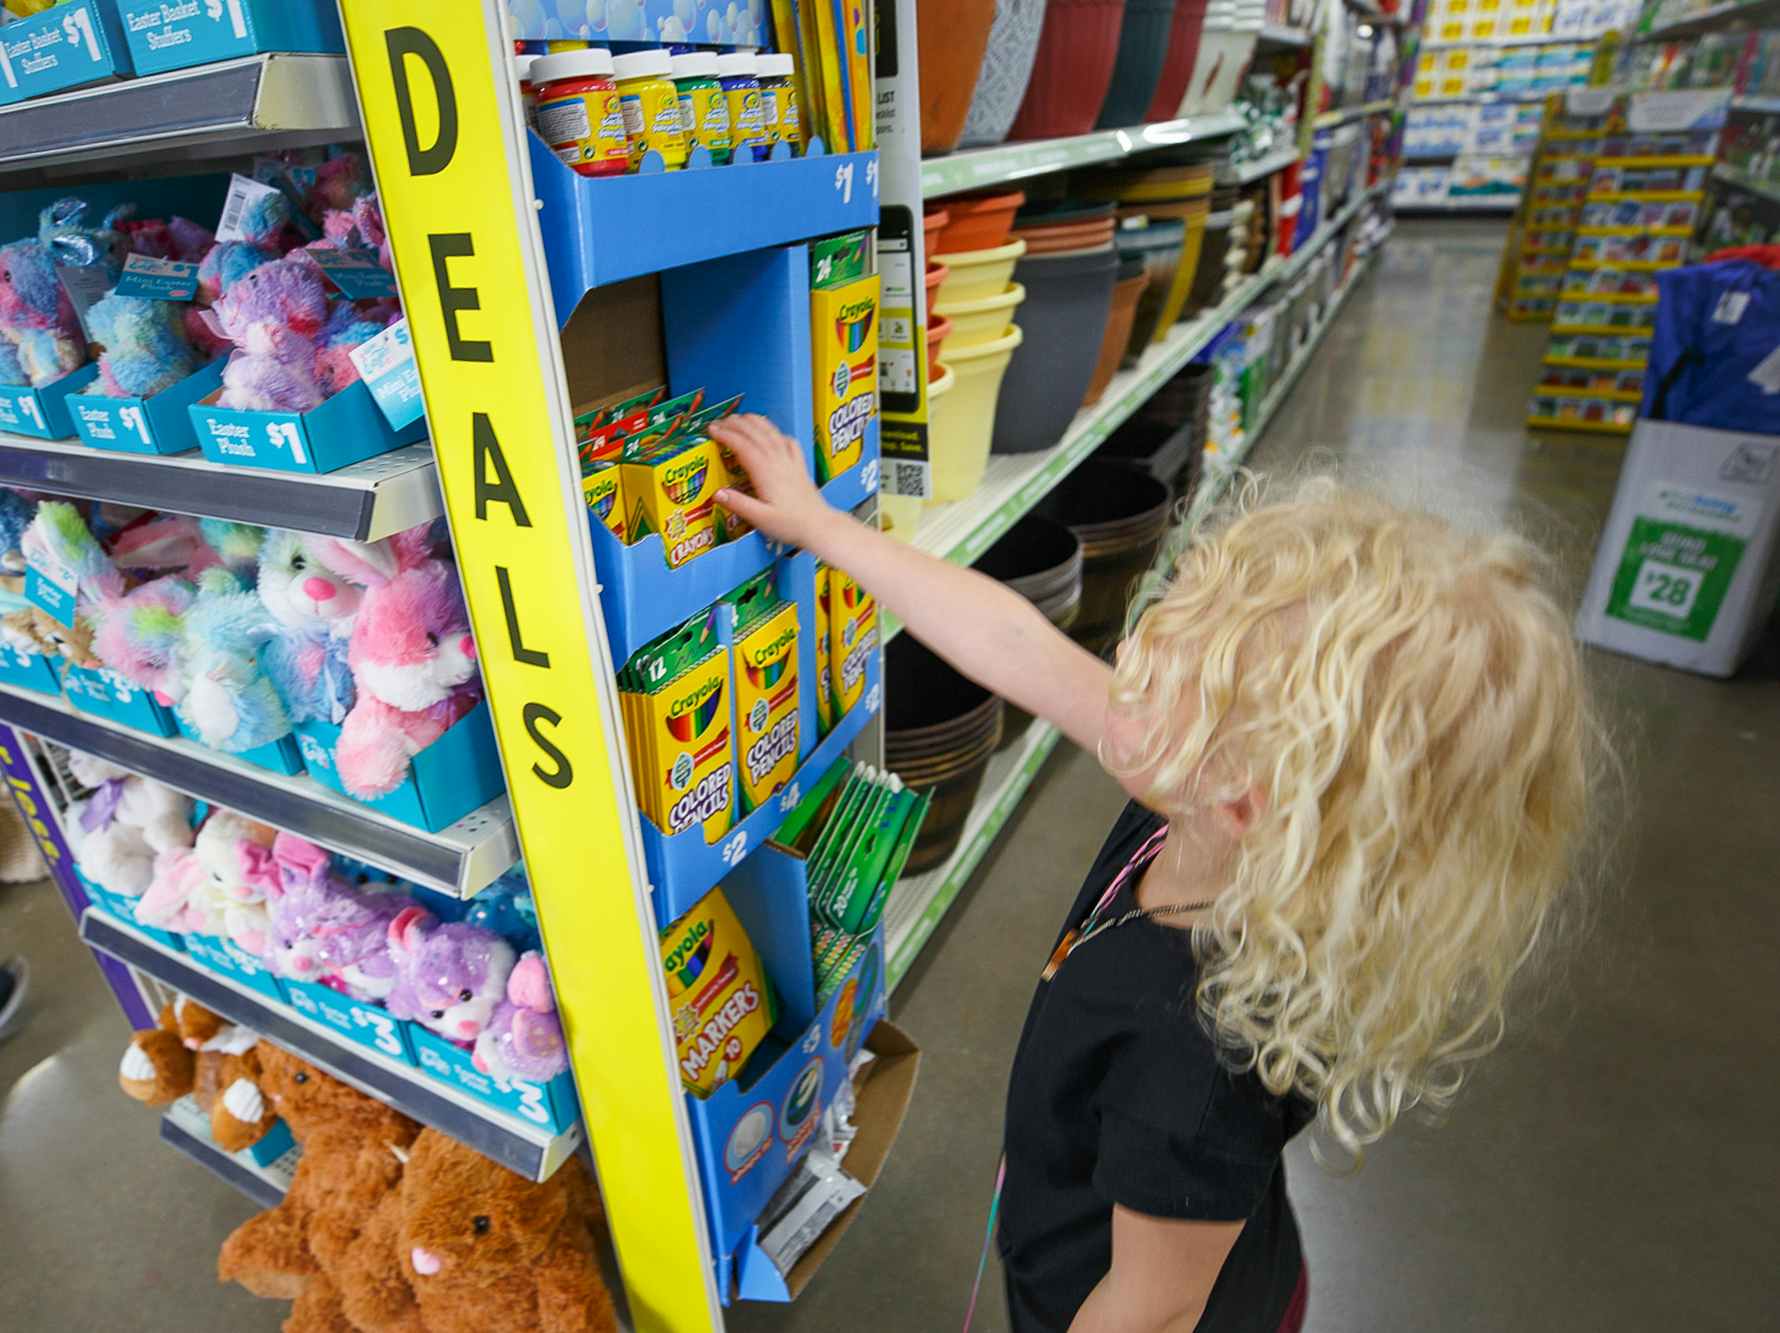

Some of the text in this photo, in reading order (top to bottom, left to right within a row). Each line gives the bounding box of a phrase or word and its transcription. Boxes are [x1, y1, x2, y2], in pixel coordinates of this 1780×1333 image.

[62, 7, 101, 62] $1
[127, 1, 200, 32] Easter Basket
[4, 27, 63, 59] Easter Basket
[146, 28, 192, 50] Stuffers
[835, 162, 854, 204] $1
[17, 396, 46, 430] $1
[78, 405, 110, 422] Easter
[119, 406, 151, 445] $1
[384, 26, 574, 789] DEALS
[206, 418, 250, 439] Easter
[216, 437, 257, 457] Plush
[265, 421, 307, 465] $1
[665, 455, 705, 484] Crayola
[754, 628, 796, 665] Crayola
[648, 656, 667, 683] 12
[672, 677, 721, 717] Crayola
[747, 709, 798, 768] COLORED
[669, 760, 731, 828] COLORED
[722, 831, 747, 867] $2
[664, 921, 708, 972] ayola
[350, 1007, 402, 1056] $3
[680, 979, 759, 1081] MARKERS
